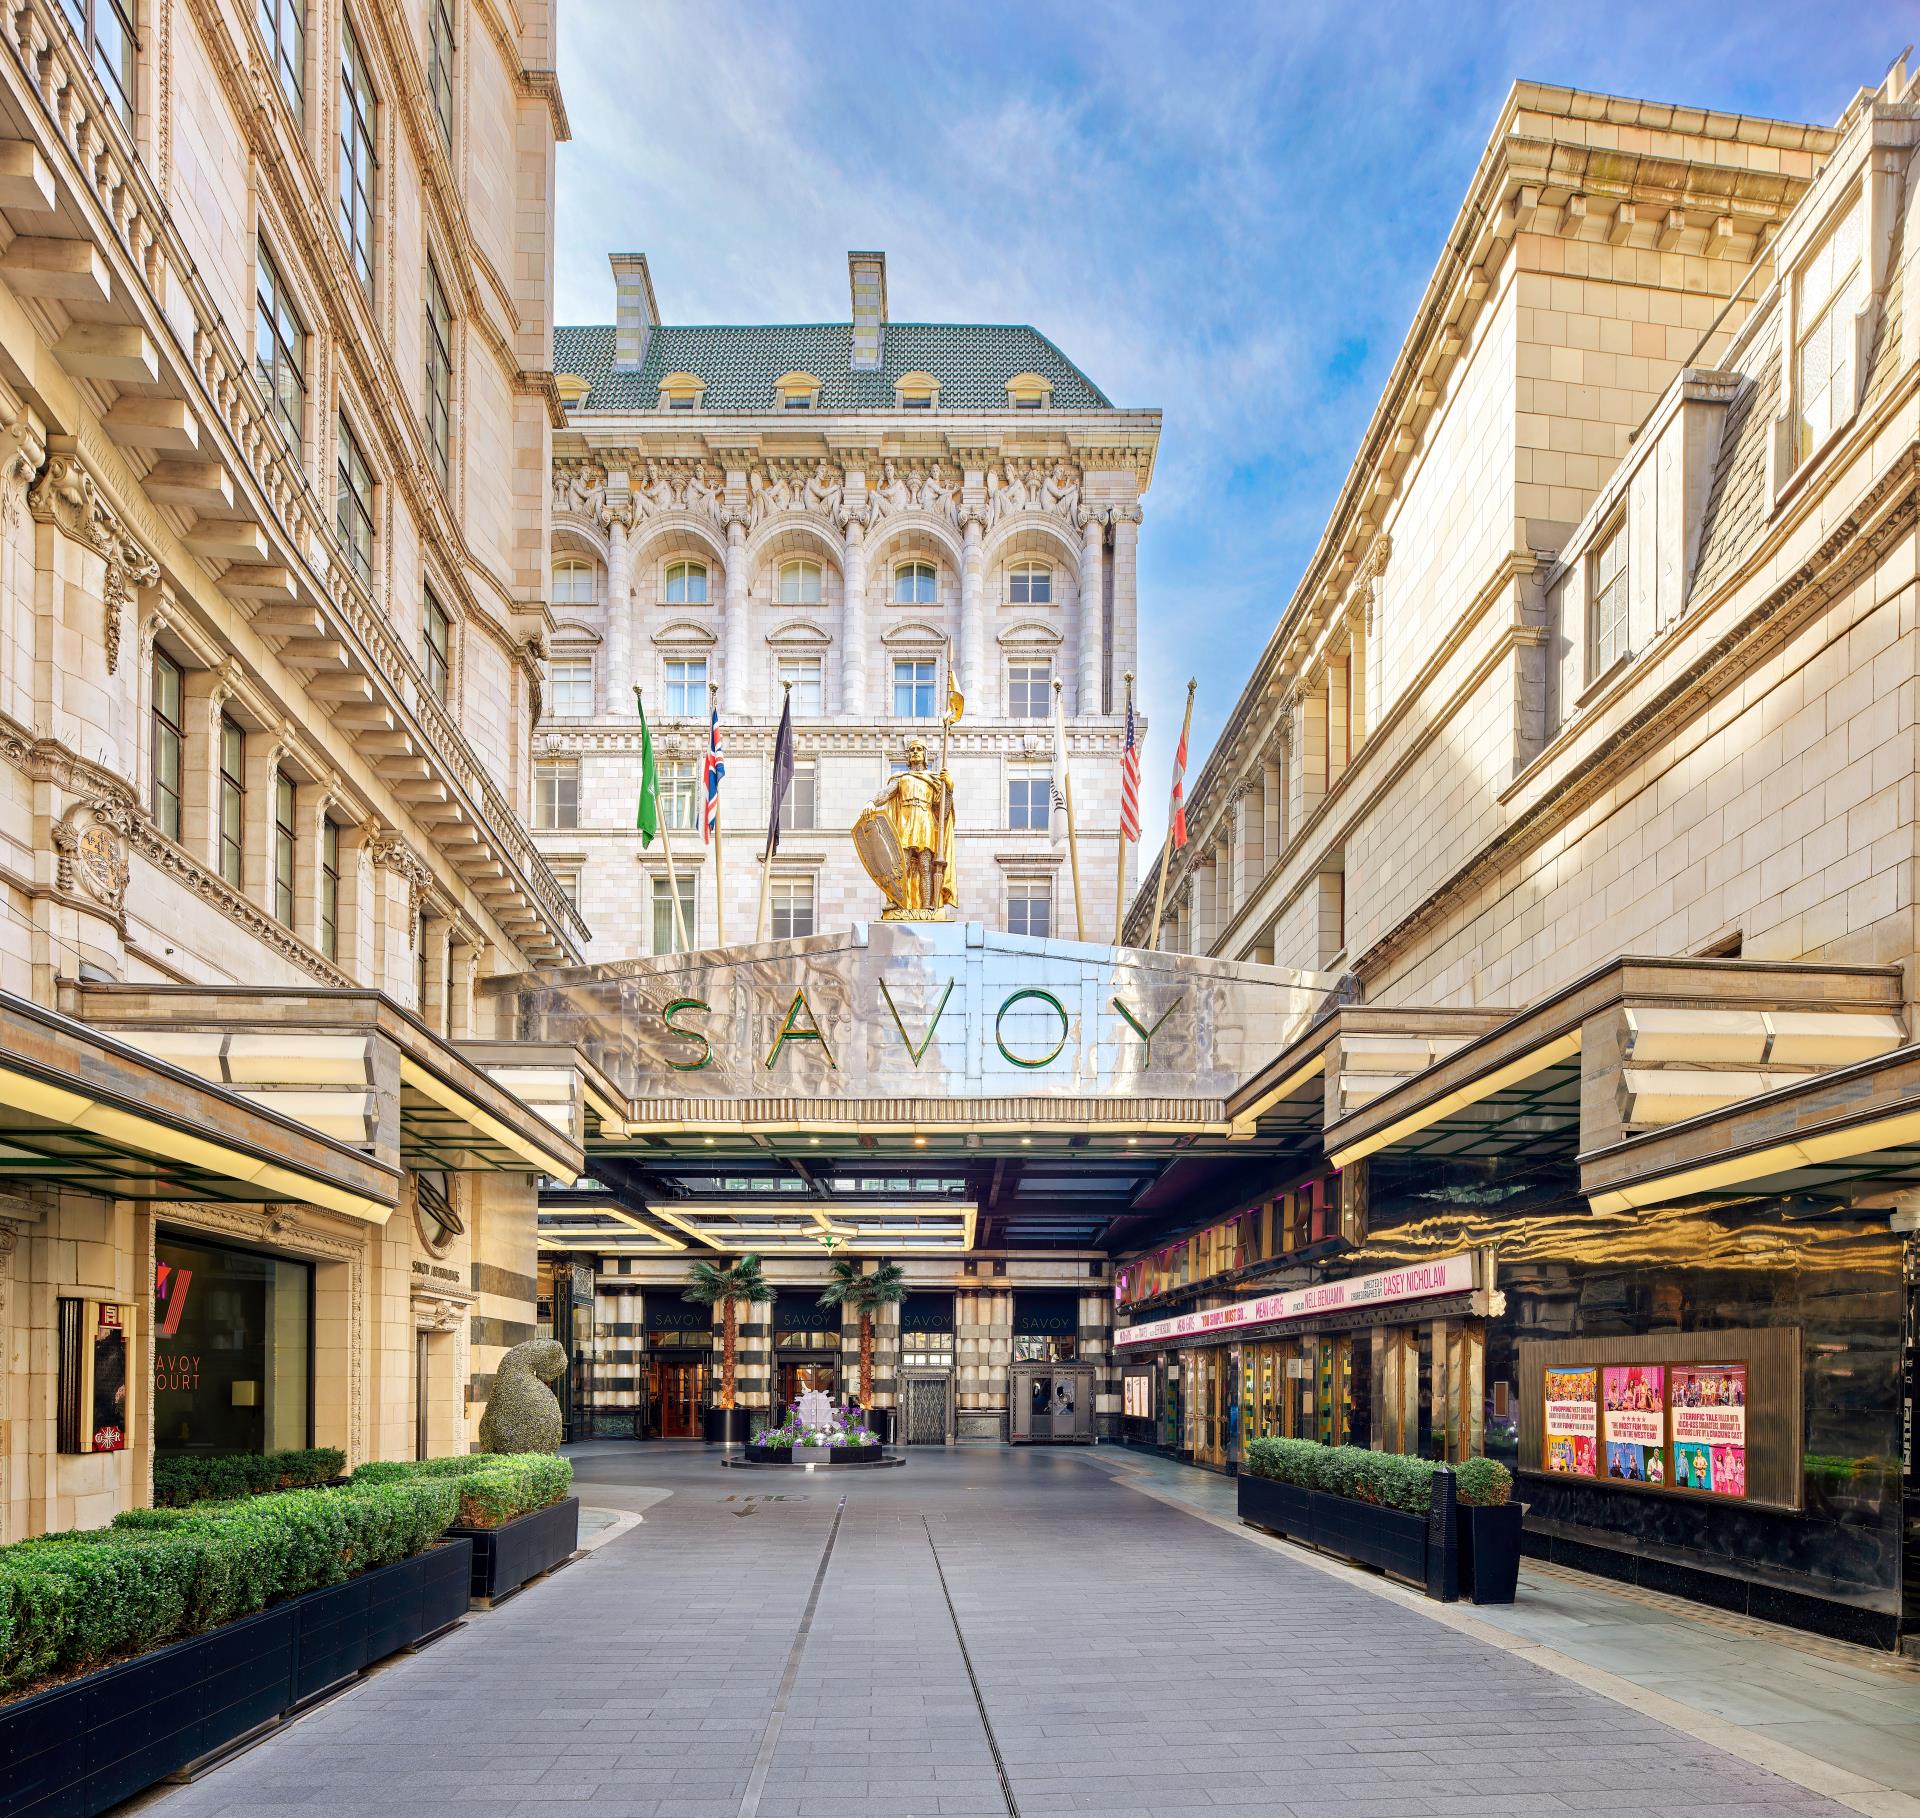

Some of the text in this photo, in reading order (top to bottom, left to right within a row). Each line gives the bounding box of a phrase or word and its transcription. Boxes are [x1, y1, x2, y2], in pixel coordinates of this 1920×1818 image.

[662, 976, 1185, 1072] SAVOY
[1383, 1265, 1446, 1296] CASEY NICHOLAW
[655, 1314, 703, 1326] SAVOY
[783, 1314, 831, 1326] SAVOY
[904, 1315, 951, 1328] SAVOY
[1022, 1317, 1070, 1330] SAVOY
[155, 1355, 200, 1372] AVOY
[155, 1373, 200, 1391] OURT
